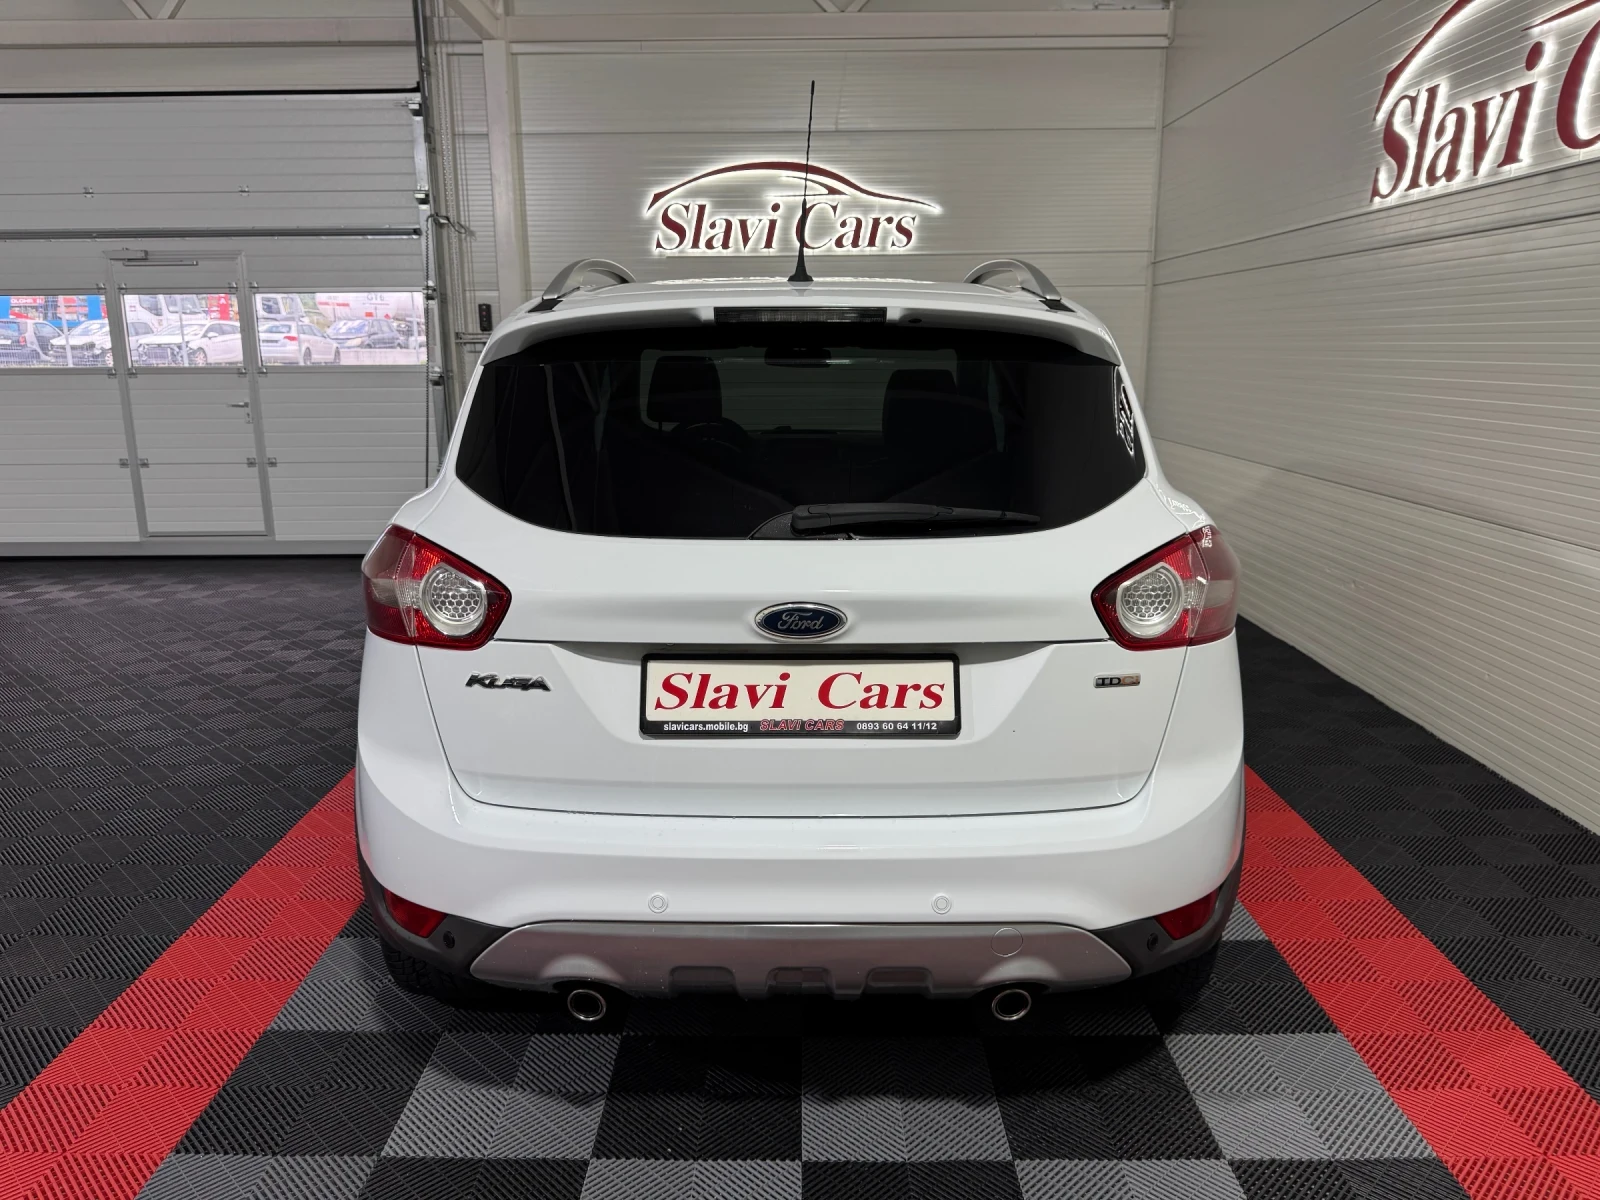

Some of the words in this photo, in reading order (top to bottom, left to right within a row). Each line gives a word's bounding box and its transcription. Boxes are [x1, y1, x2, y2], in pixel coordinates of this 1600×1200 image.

[1370, 41, 1545, 203] Slavi
[655, 202, 780, 250] Slavi
[796, 201, 917, 250] Cars
[777, 611, 825, 630] Ford
[465, 672, 552, 692] KUGA
[654, 672, 791, 711] Slavi
[817, 671, 946, 710] Cars
[663, 721, 749, 732] slavicars.mobile.bg
[760, 719, 802, 731] SLAVI
[804, 719, 845, 731] CARS
[856, 722, 880, 730] 0893
[882, 722, 894, 730] 60
[896, 722, 909, 730] 64
[911, 722, 938, 731] 11/12
